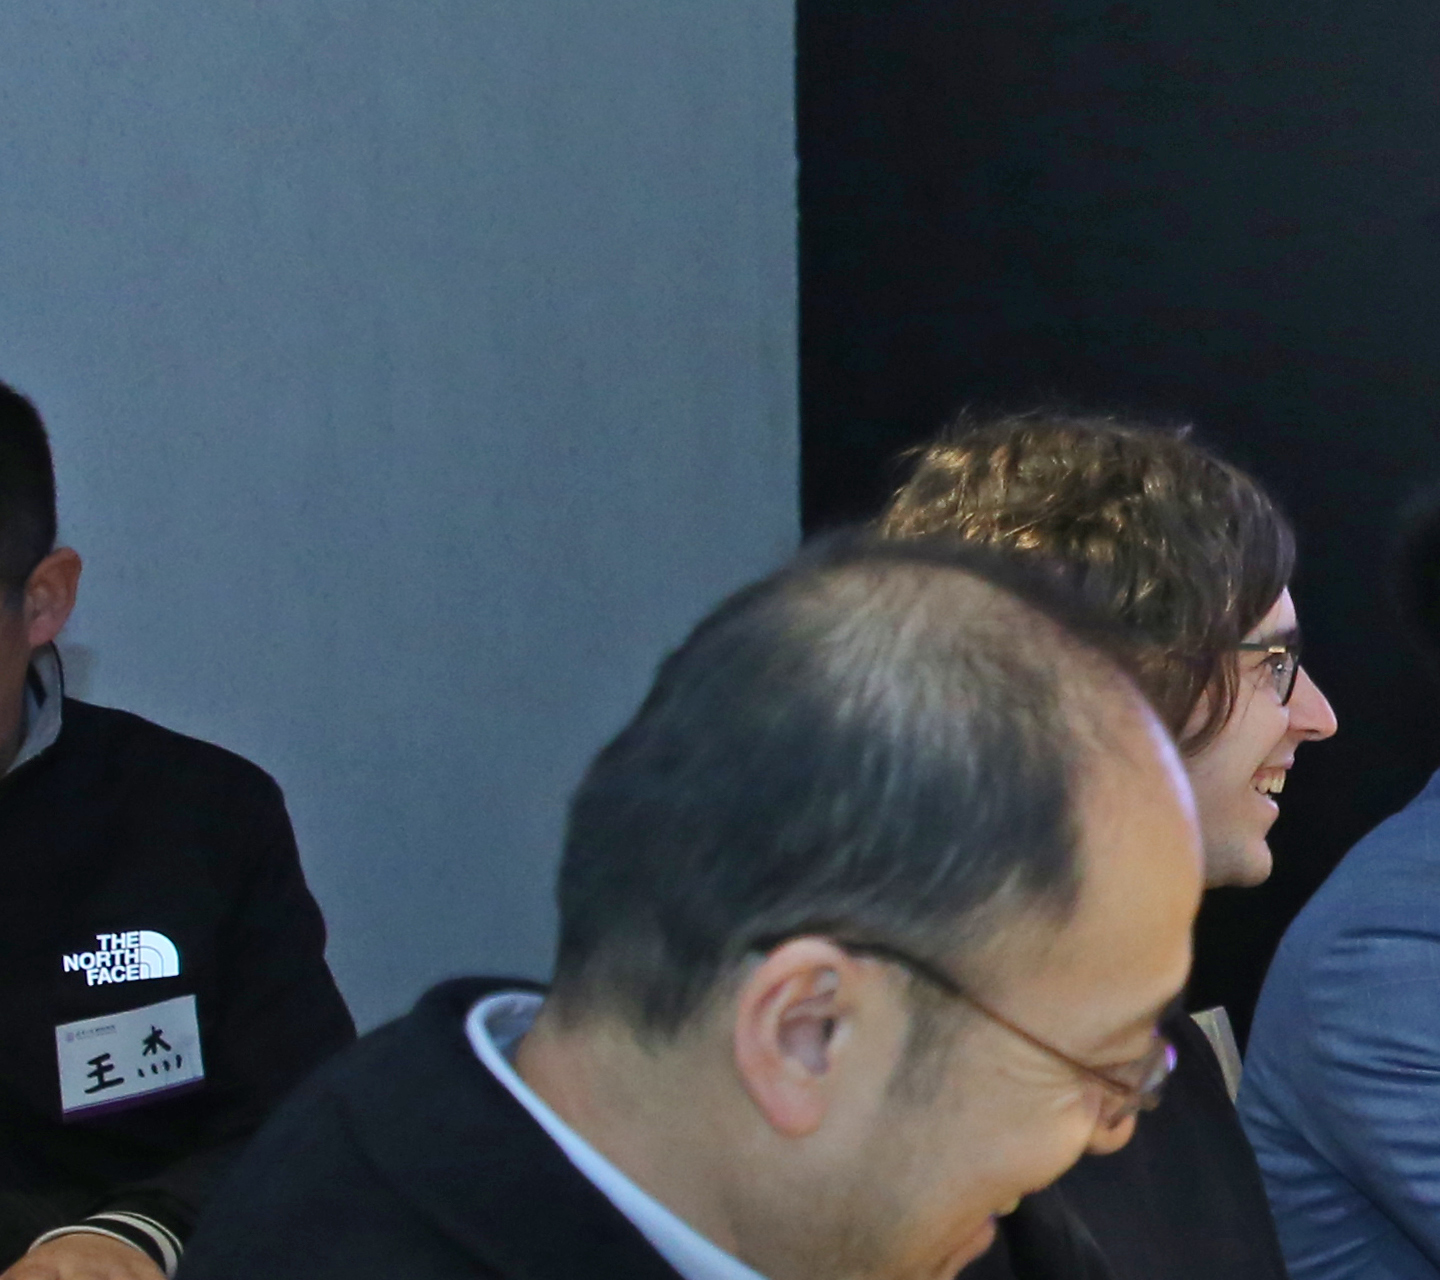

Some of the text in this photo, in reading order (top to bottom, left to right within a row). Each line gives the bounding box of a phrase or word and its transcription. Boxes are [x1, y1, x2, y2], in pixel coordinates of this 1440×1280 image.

[96, 931, 140, 951] THE
[63, 948, 140, 972] NORTH
[86, 965, 140, 986] FACE
[84, 1025, 182, 1094] 王杰
